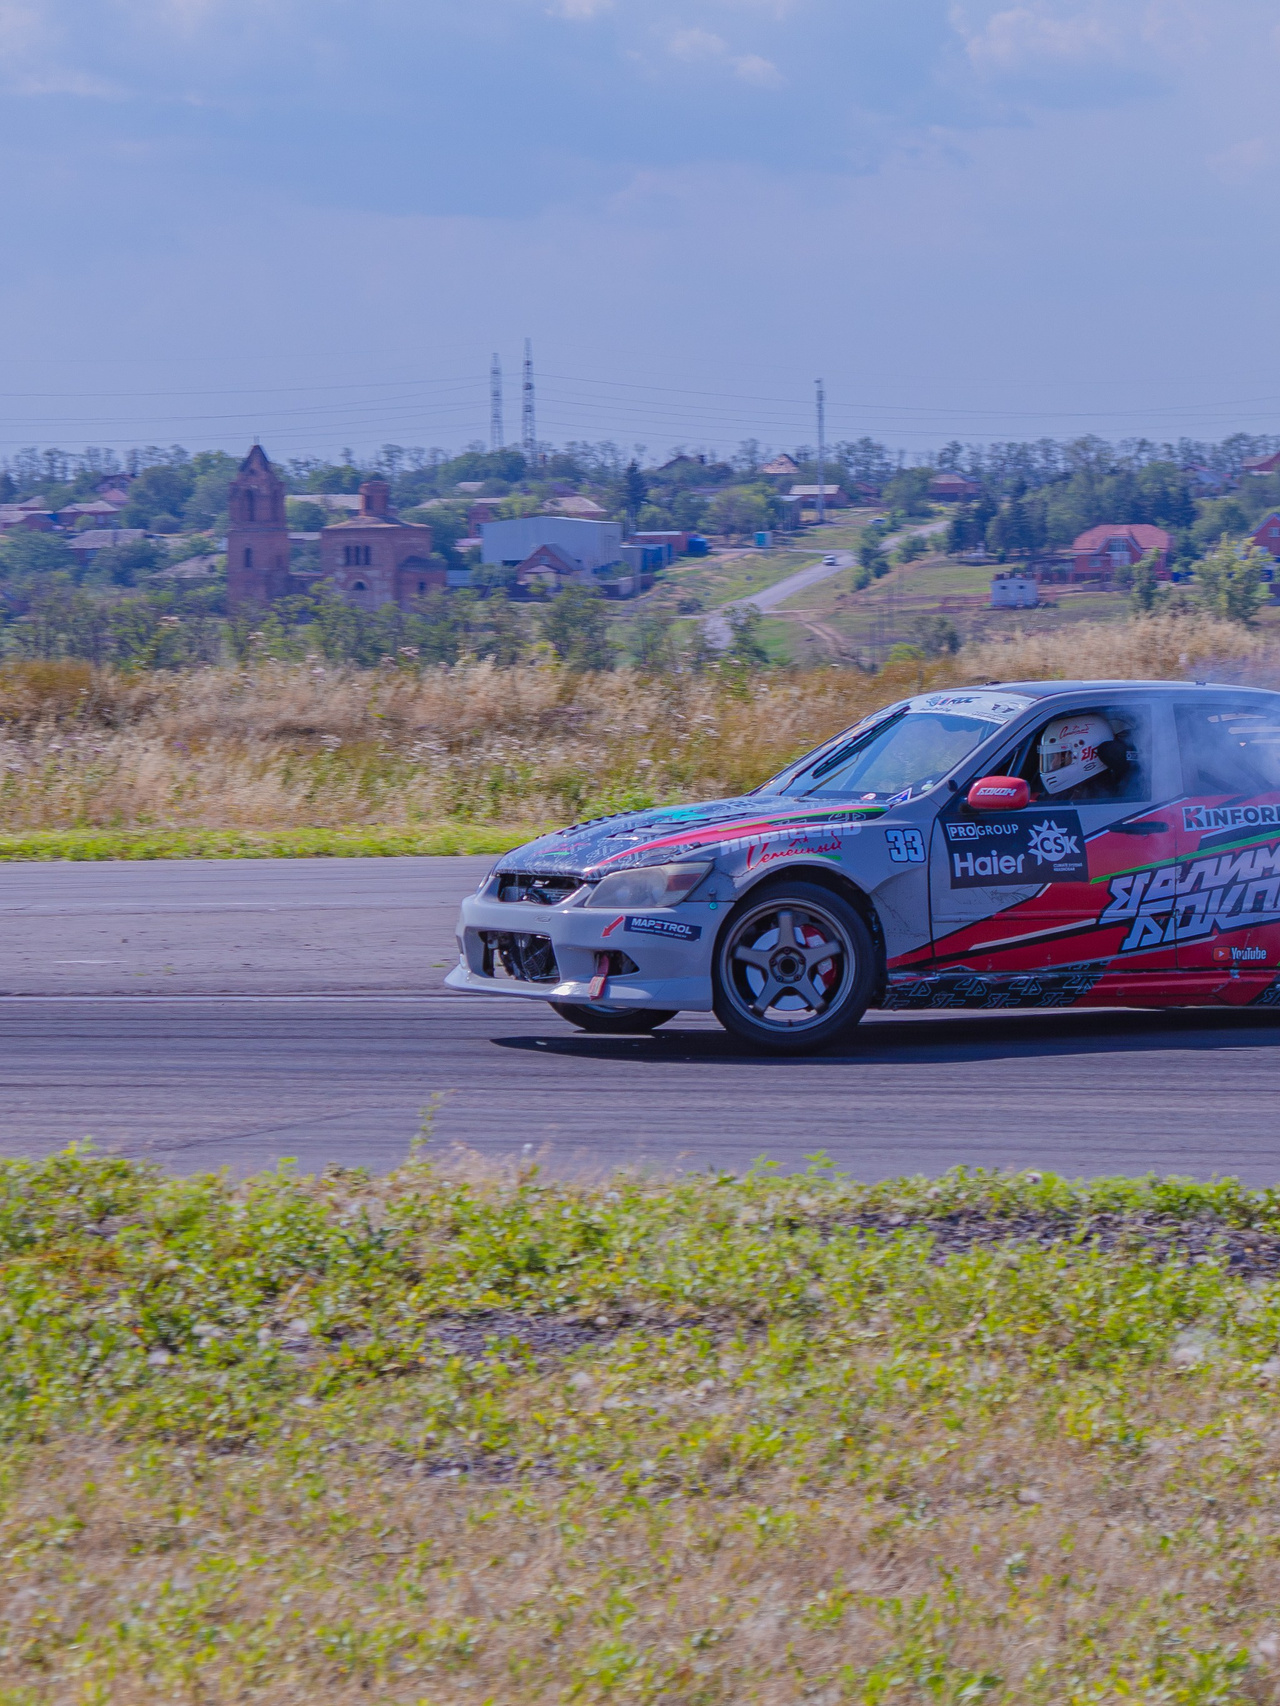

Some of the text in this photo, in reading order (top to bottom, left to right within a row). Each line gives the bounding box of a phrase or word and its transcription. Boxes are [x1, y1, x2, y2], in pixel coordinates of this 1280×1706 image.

[976, 787, 1017, 797] БОКОМ
[885, 828, 926, 863] 33
[1040, 836, 1081, 854] CSK
[953, 850, 1025, 877] Haier
[631, 917, 692, 935] MAPETROL
[1231, 947, 1267, 960] YouTube
